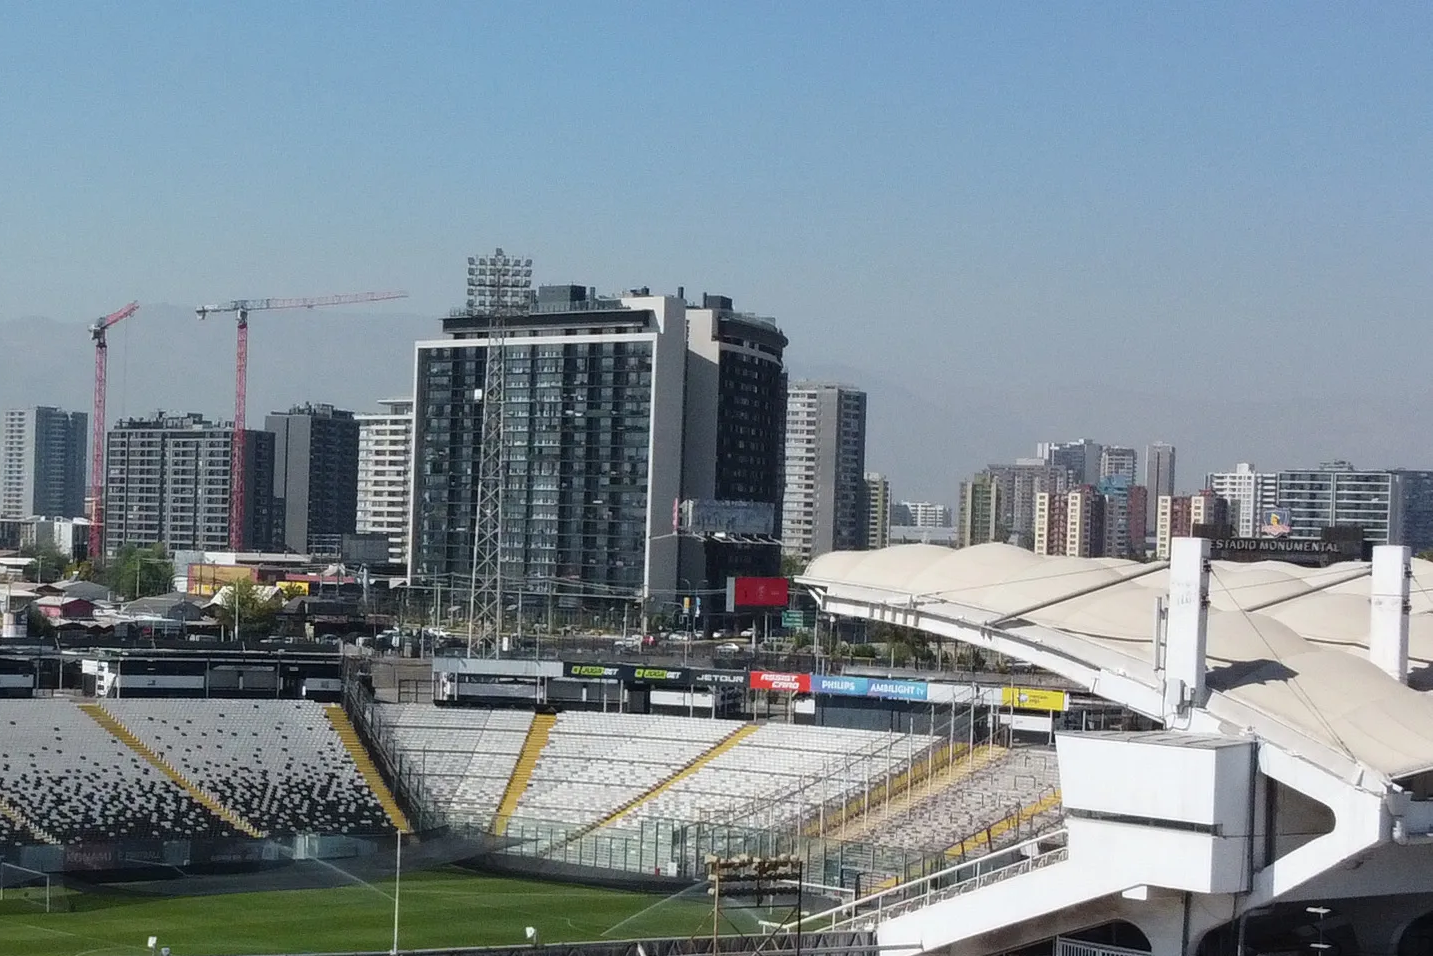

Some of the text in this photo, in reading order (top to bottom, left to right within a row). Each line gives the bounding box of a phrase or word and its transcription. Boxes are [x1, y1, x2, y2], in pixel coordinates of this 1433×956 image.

[1211, 539, 1339, 552] ESTADIO MONUMENTAL
[696, 674, 744, 683] JETOUR
[821, 680, 855, 691] PHILIPS
[870, 683, 915, 695] AMBILIGHT
